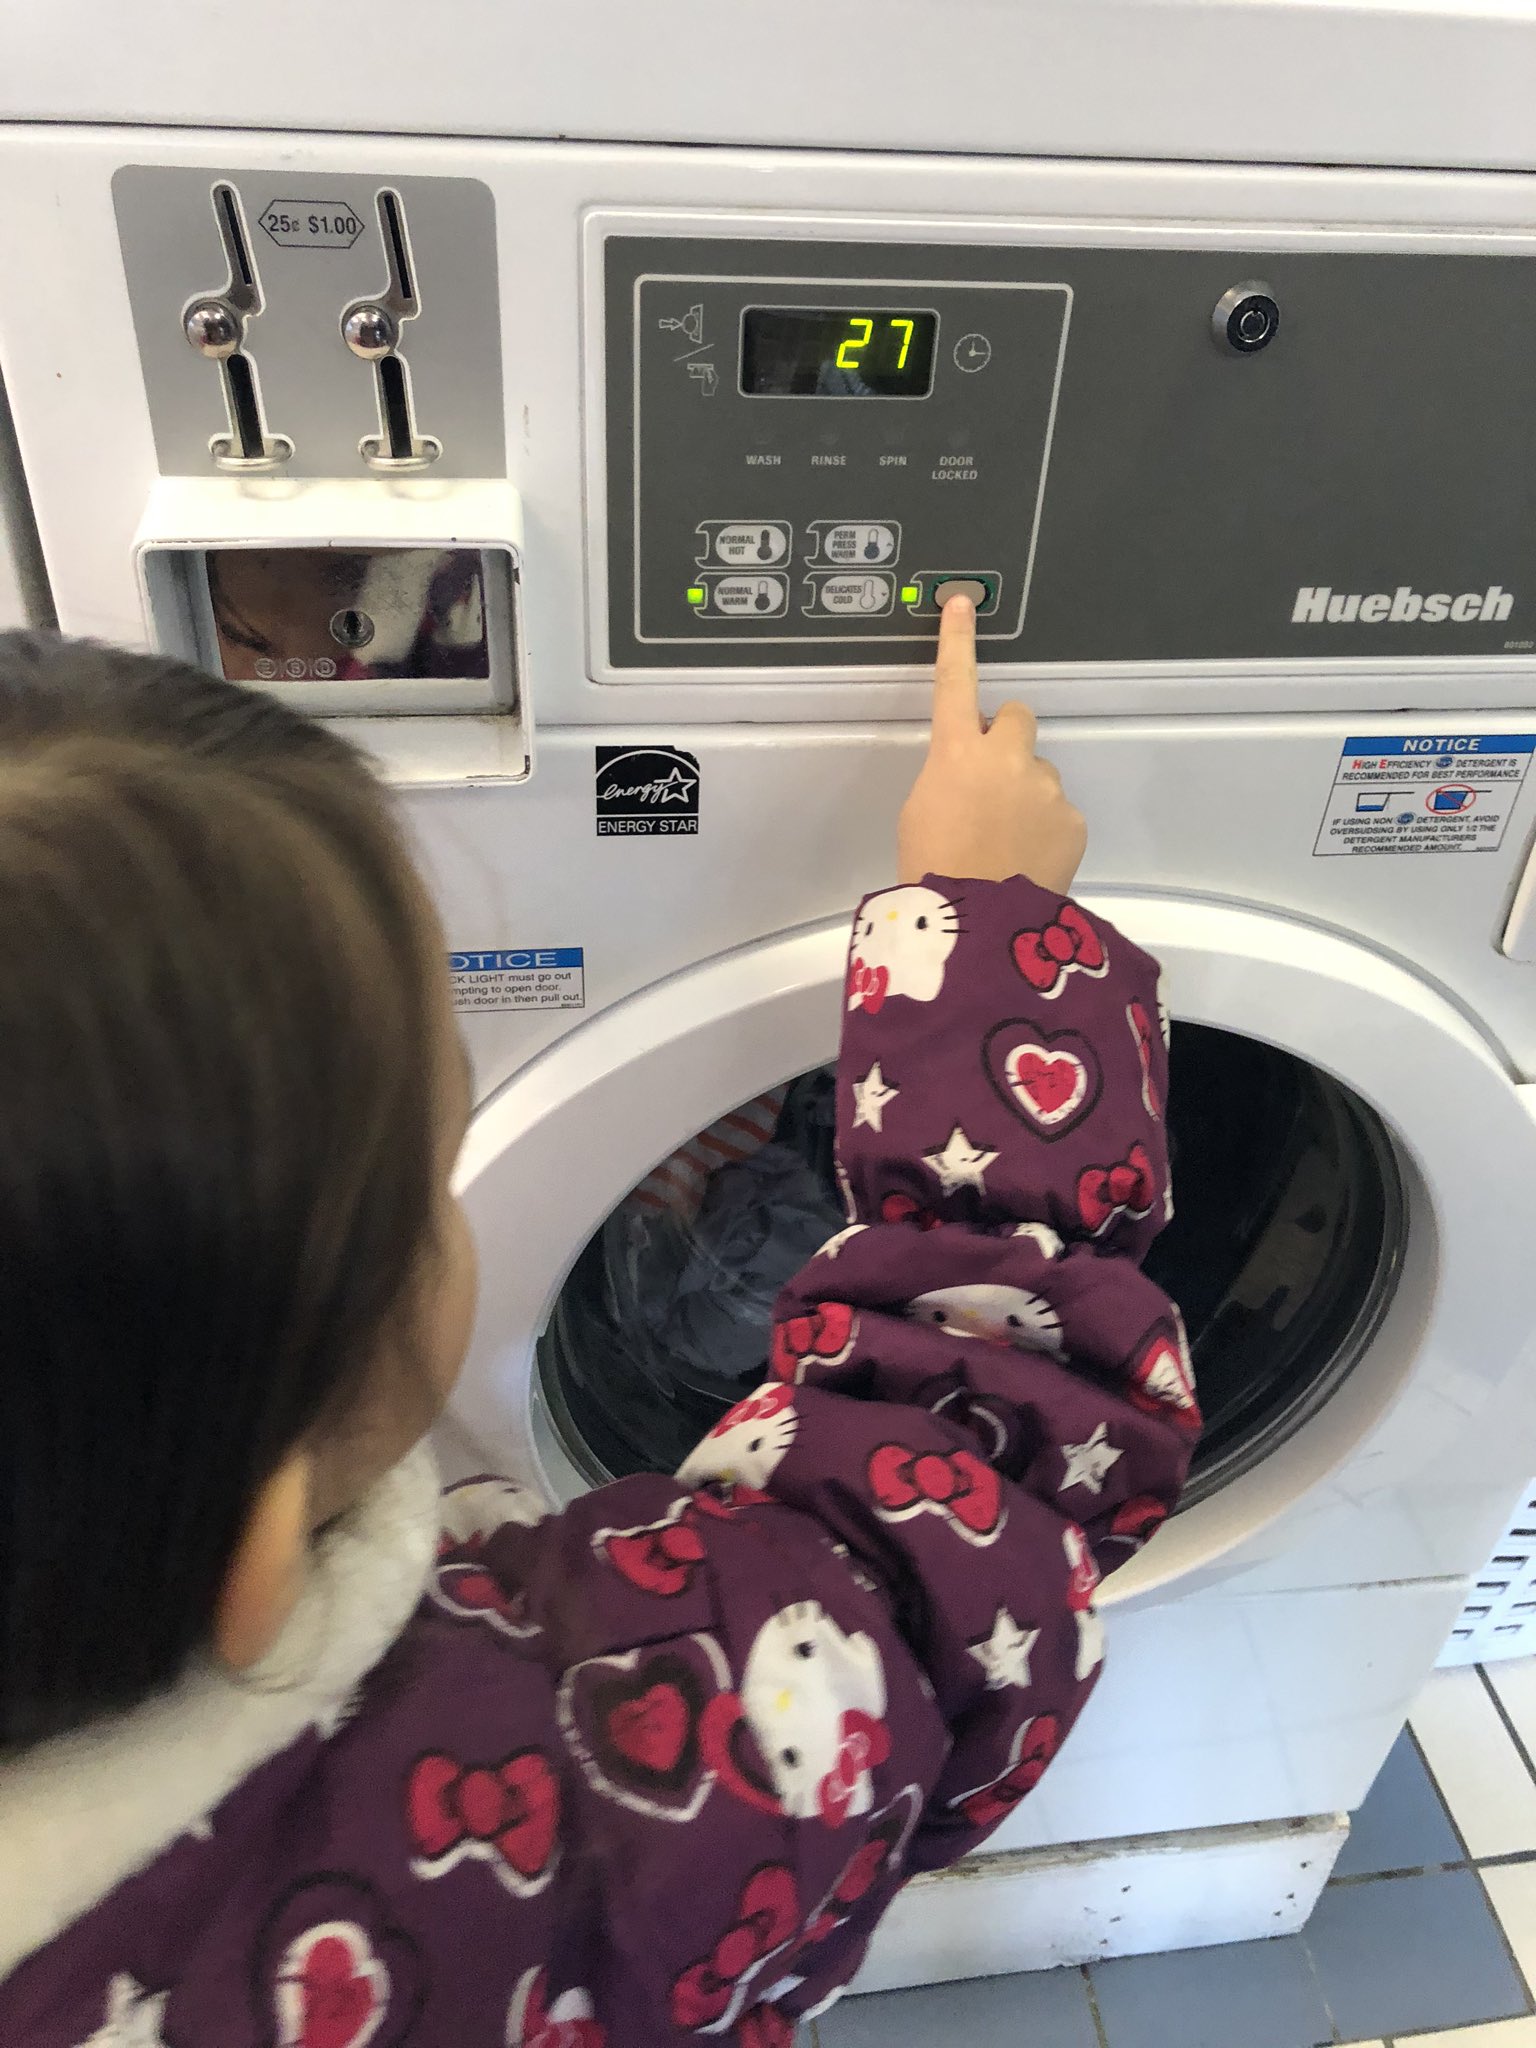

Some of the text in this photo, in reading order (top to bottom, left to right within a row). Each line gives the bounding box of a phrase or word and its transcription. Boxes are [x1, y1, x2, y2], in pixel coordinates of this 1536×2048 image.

[308, 215, 357, 235] $1.00
[836, 318, 914, 369] 27
[746, 455, 782, 466] WASH
[811, 455, 847, 466] RINSE
[879, 455, 908, 466] SPIN
[939, 456, 974, 466] DOOR
[931, 470, 978, 480] LOCKED
[719, 535, 756, 545] NORMAL
[834, 531, 856, 540] PERM
[832, 540, 857, 549] PRESS
[729, 547, 745, 555] HOT
[831, 551, 856, 559] WARM
[717, 587, 753, 596] NORMAL
[825, 585, 862, 594] DELICATES
[722, 597, 748, 606] WARM
[833, 595, 853, 604] COLD
[1291, 586, 1514, 623] Huebsch
[1403, 738, 1481, 751] NOTICE
[1352, 759, 1377, 769] HIGH
[1379, 759, 1431, 769] EFFICIENCY
[1456, 759, 1508, 768] DETERGENT
[1509, 759, 1517, 767] IS
[1342, 769, 1520, 780] RECOMMENDED FOR BEST PERFORMANCE
[1343, 817, 1371, 825] USING
[598, 820, 697, 833] ENERGY STAR
[1330, 826, 1394, 835] OVERSUDSING
[1396, 826, 1409, 834] BY
[1411, 825, 1438, 834] USING
[1440, 825, 1463, 833] ONLY
[1479, 824, 1496, 832] THE
[1343, 834, 1476, 844] DETERGENT MANUFACTURERS
[1352, 844, 1422, 853] RECOMMENDED
[451, 952, 557, 970] OTICE
[450, 972, 571, 984] CK LIGHT must go out
[452, 986, 488, 996] mpting
[491, 985, 501, 993] to
[505, 984, 532, 994] open
[473, 996, 499, 1005] door
[501, 995, 512, 1003] in
[514, 994, 538, 1003] then
[541, 994, 559, 1003] pull
